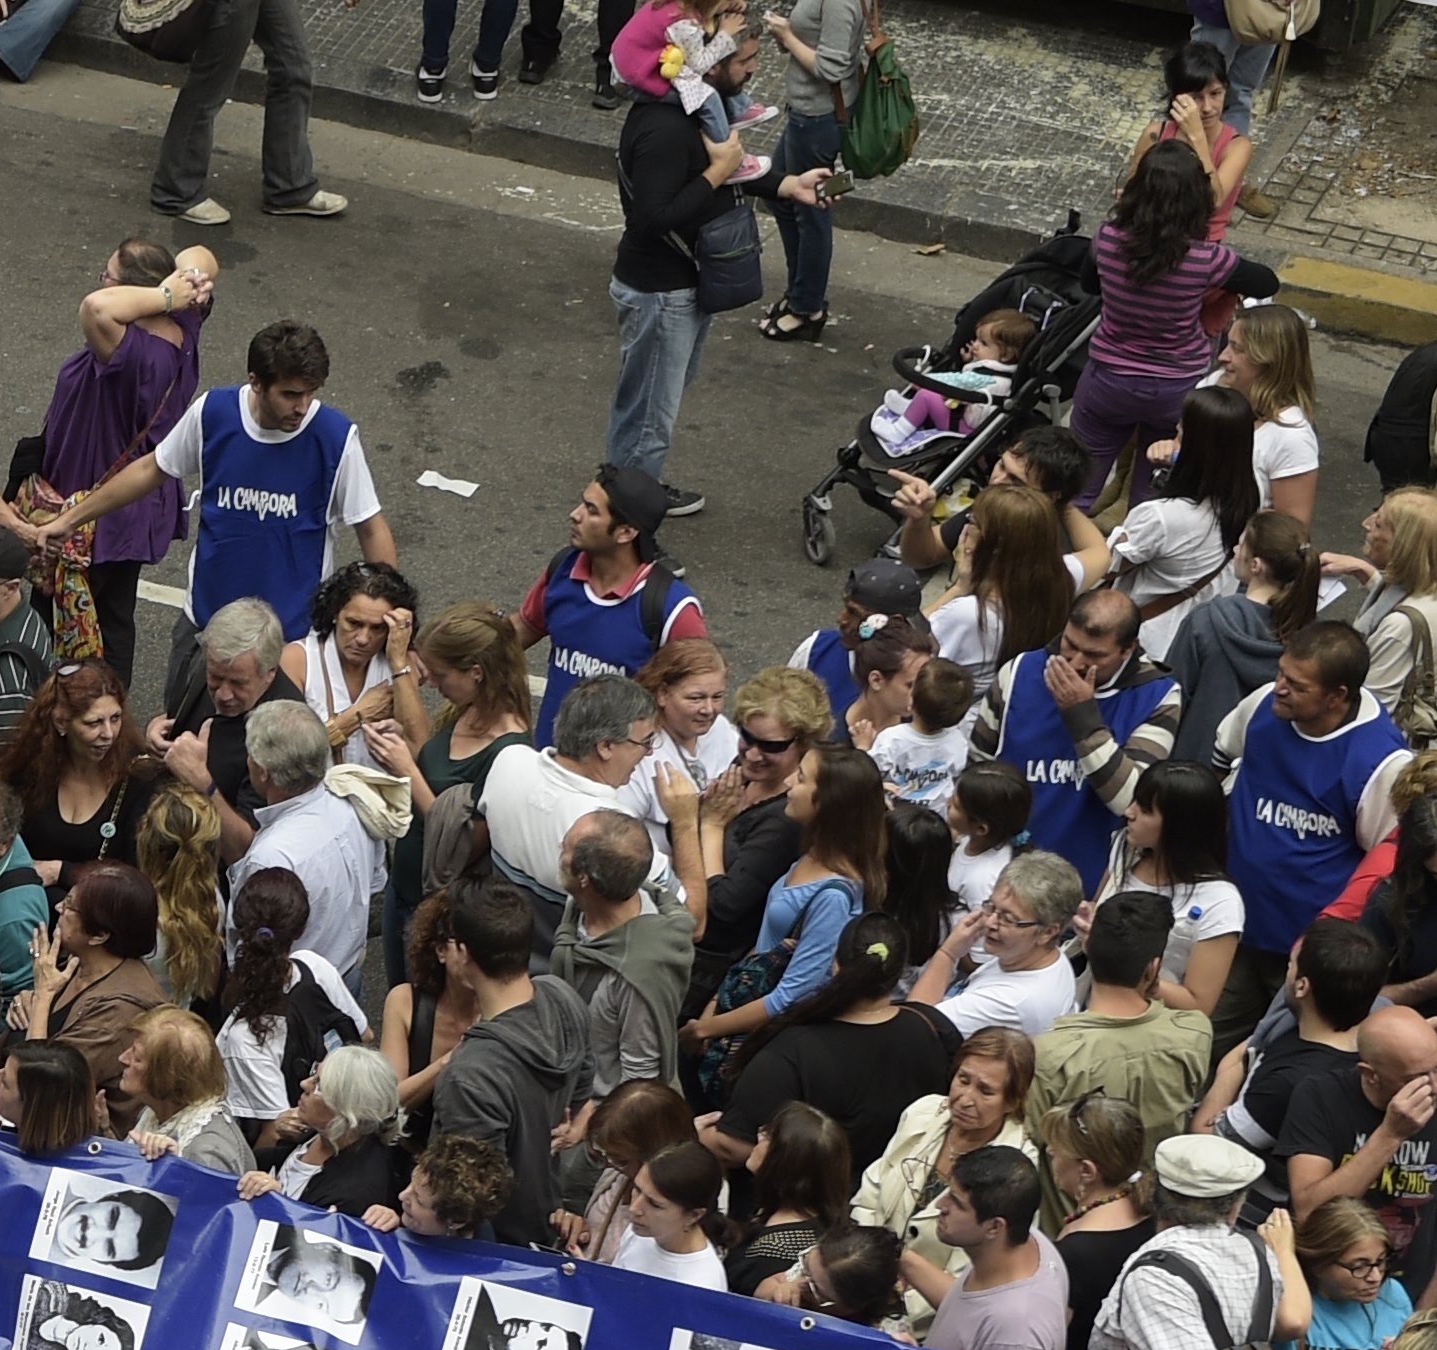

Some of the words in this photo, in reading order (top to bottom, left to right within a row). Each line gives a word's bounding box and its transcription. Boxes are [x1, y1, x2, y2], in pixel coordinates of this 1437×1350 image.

[218, 486, 231, 510] LA
[233, 487, 297, 521] CAMPORA
[555, 647, 568, 671] LA
[1026, 760, 1047, 783] LA
[1256, 797, 1273, 824] LA
[1274, 802, 1341, 839] CAMPORA
